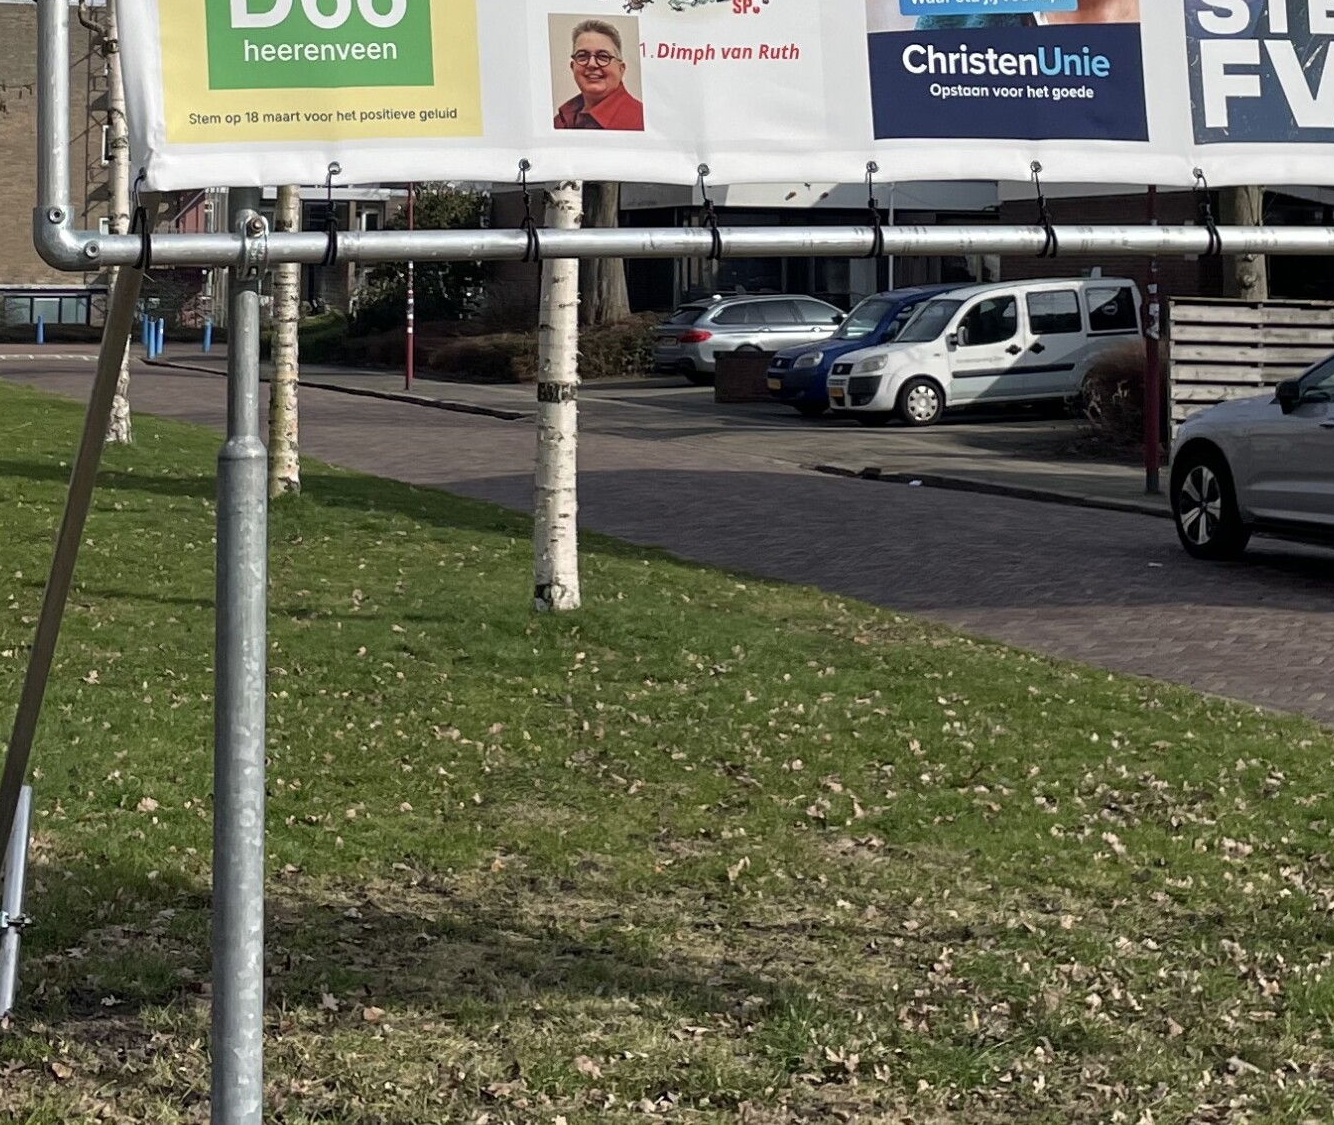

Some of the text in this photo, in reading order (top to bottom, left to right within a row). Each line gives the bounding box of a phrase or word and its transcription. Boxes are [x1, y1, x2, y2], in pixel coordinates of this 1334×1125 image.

[244, 37, 397, 63] heerenveen
[657, 43, 715, 65] Dimph
[721, 47, 752, 59] van
[758, 43, 800, 60] Ruth
[902, 44, 1110, 77] ChristenUnie
[930, 83, 1094, 100] Opstaan voor het goede
[189, 107, 457, 129] Stem op 18 maart voor het positieve geluid
